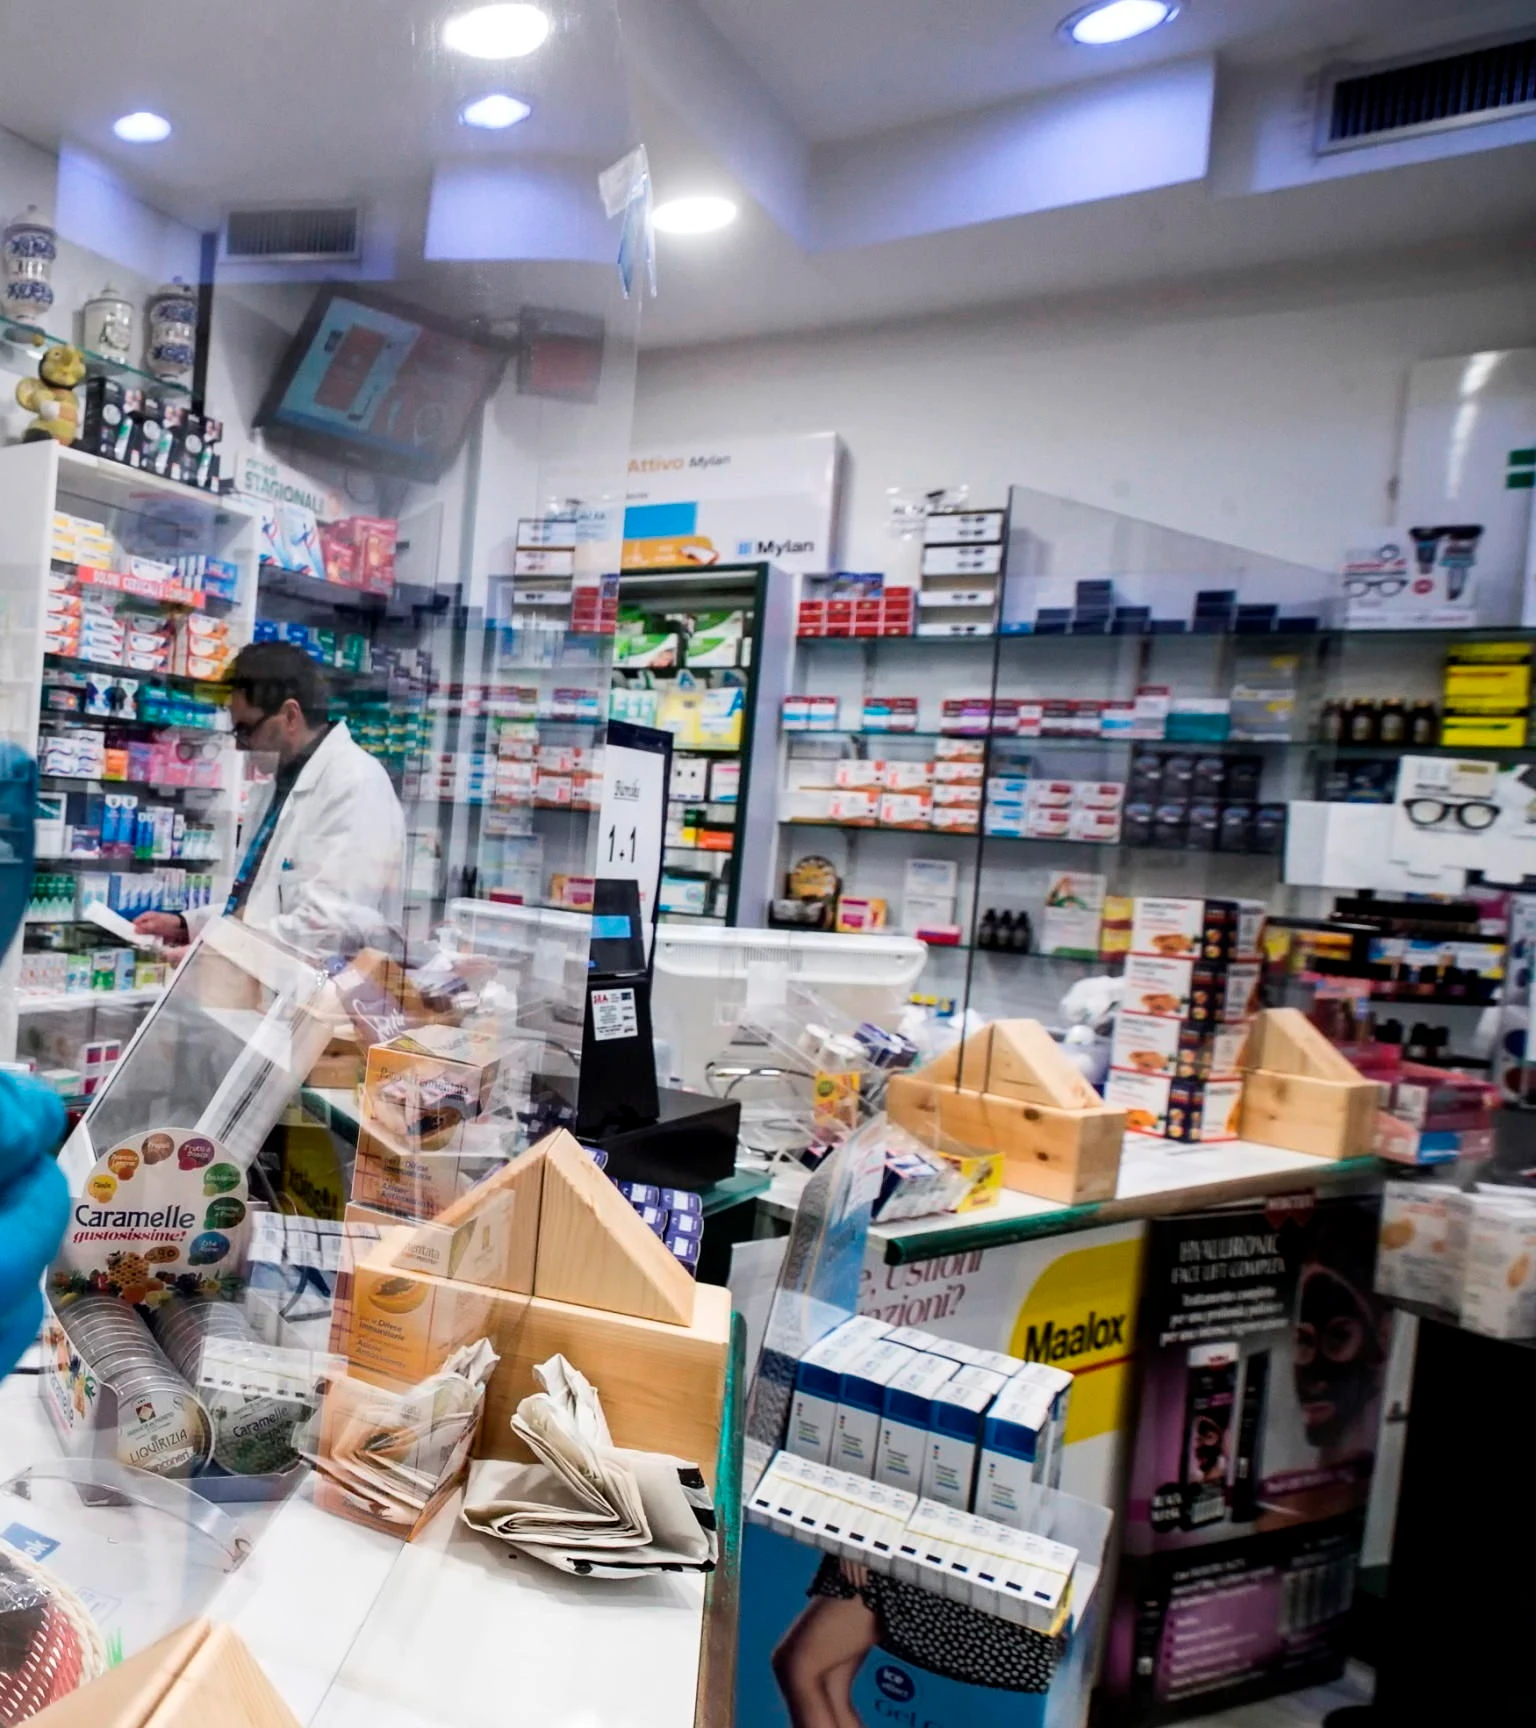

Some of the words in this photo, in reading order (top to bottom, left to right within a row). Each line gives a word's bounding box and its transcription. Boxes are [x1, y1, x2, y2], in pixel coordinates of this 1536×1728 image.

[627, 457, 684, 475] Attivo
[757, 540, 815, 556] Mylan
[75, 1204, 195, 1229] Caramelle
[73, 1228, 186, 1243] gustosissime!
[1024, 1311, 1125, 1364] Maalox
[233, 1405, 290, 1438] Caramelle
[129, 1429, 188, 1464] LIQUIRIZIA
